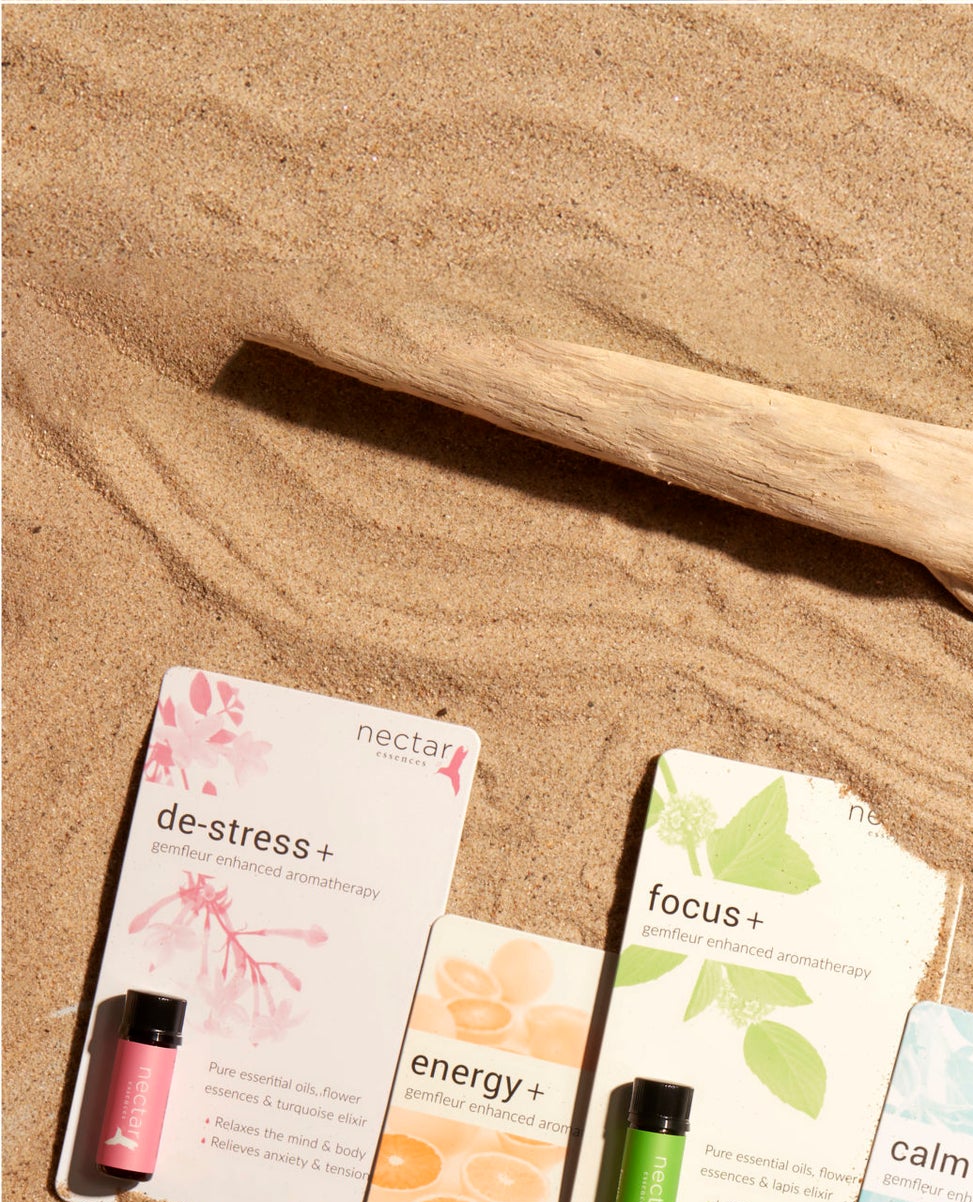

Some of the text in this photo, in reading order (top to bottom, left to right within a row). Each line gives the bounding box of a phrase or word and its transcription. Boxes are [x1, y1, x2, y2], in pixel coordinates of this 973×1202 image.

[357, 723, 453, 759] nectar
[376, 750, 427, 767] essences
[151, 839, 381, 901] gemfleur enhanced aromatherapy
[642, 923, 872, 981] gemfleur enhanced aromatherapy
[127, 1066, 151, 1140] nectar
[209, 1062, 236, 1077] Pure
[240, 1071, 292, 1090] essential
[322, 1086, 362, 1104] flower
[204, 1084, 368, 1127] essences & turquoise elixir
[404, 1087, 466, 1109] gemfleur
[469, 1102, 536, 1126] enhanced
[211, 1136, 369, 1182] Relieves anxiety & tension
[215, 1116, 366, 1161] Relaxes the mind & body
[700, 1167, 833, 1201] essences & lapis elixir
[705, 1145, 733, 1160] Pure
[736, 1153, 789, 1171] essential
[819, 1167, 858, 1185] flower
[883, 1172, 944, 1197] gemfleur
